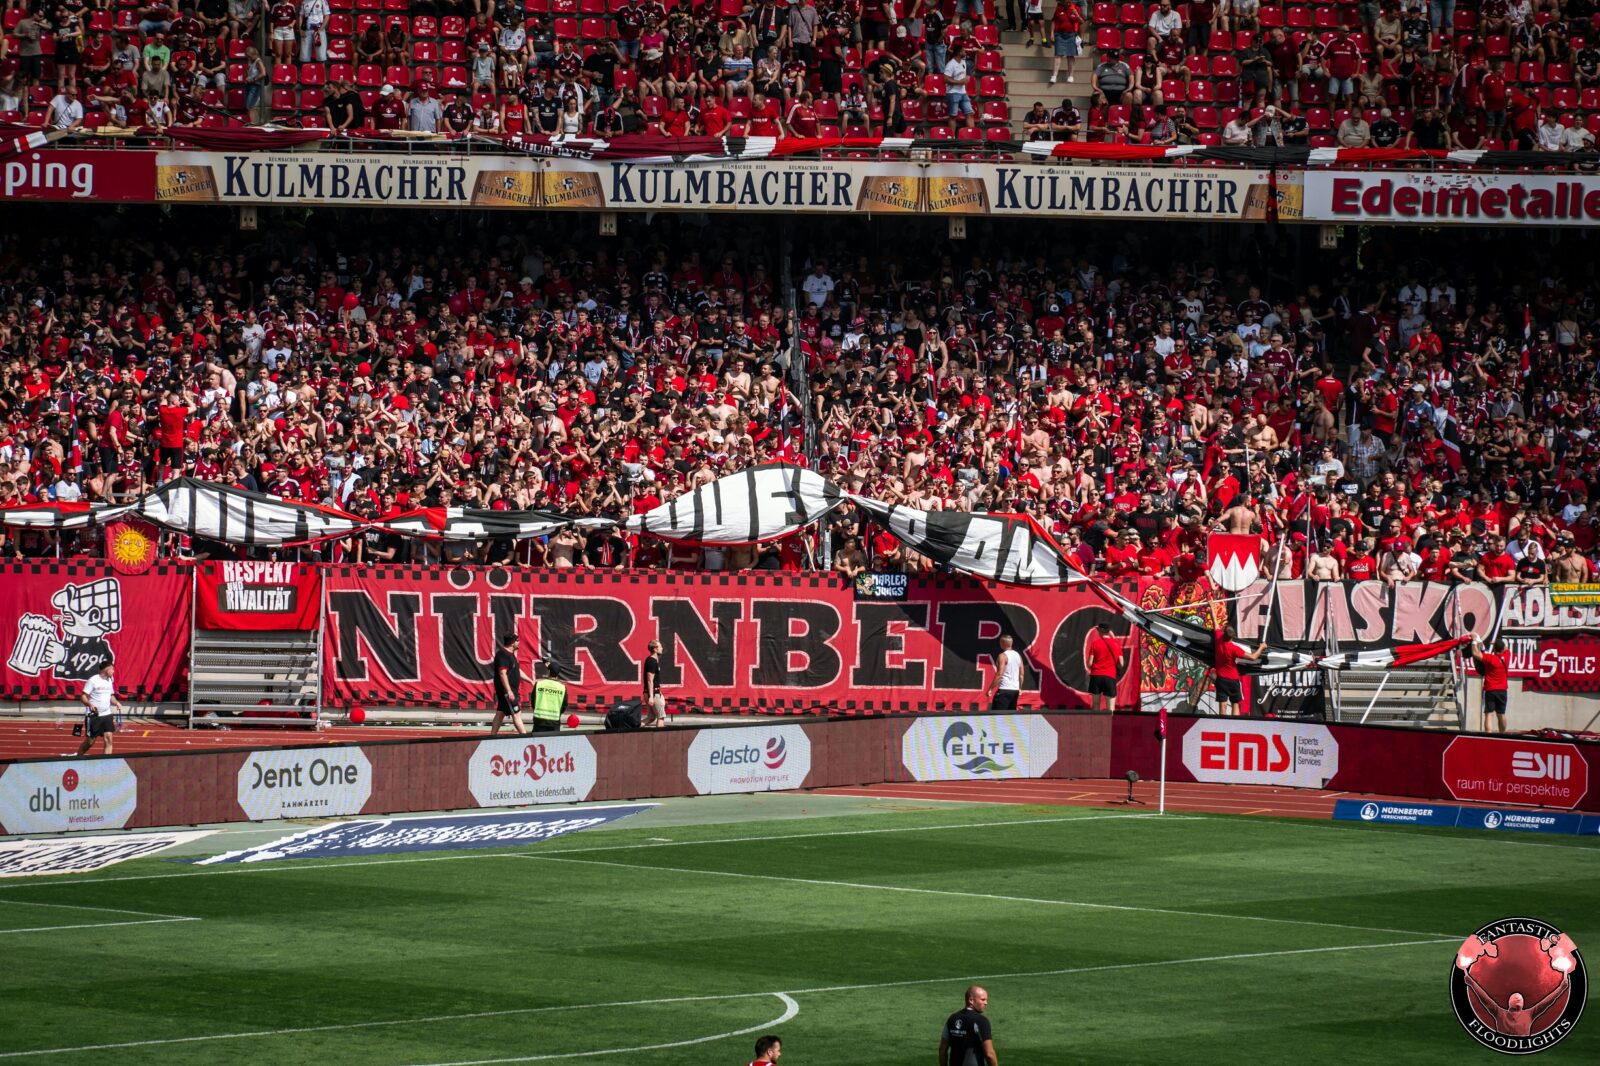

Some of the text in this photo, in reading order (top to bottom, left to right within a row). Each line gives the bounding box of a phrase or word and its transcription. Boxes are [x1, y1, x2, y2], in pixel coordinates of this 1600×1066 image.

[156, 179, 212, 199] KULMBACHER
[223, 156, 467, 201] KULMBACHER
[609, 162, 853, 206] KULMBACHER
[543, 185, 599, 205] KULMBACHER
[995, 168, 1238, 214] KULMBACHER
[223, 560, 295, 583] RESPEKT
[225, 587, 292, 610] RIVALITÄT
[1235, 578, 1498, 646] FIASKO
[326, 566, 1137, 692] NÜRNBERG
[710, 744, 760, 765] elasto
[951, 742, 1014, 756] ELITE
[1200, 731, 1319, 773] EMS Experts
[1298, 746, 1324, 758] Managed
[309, 758, 358, 786] One
[489, 743, 575, 781] Der Beck
[1298, 756, 1321, 767] Services
[29, 786, 100, 813] dbl merk
[1456, 778, 1570, 798] raum für perspektive
[281, 799, 328, 808] ZAHNÄRZTE
[1381, 806, 1433, 817] NÜRNBERGER
[1504, 814, 1556, 825] NÜRNBERGER
